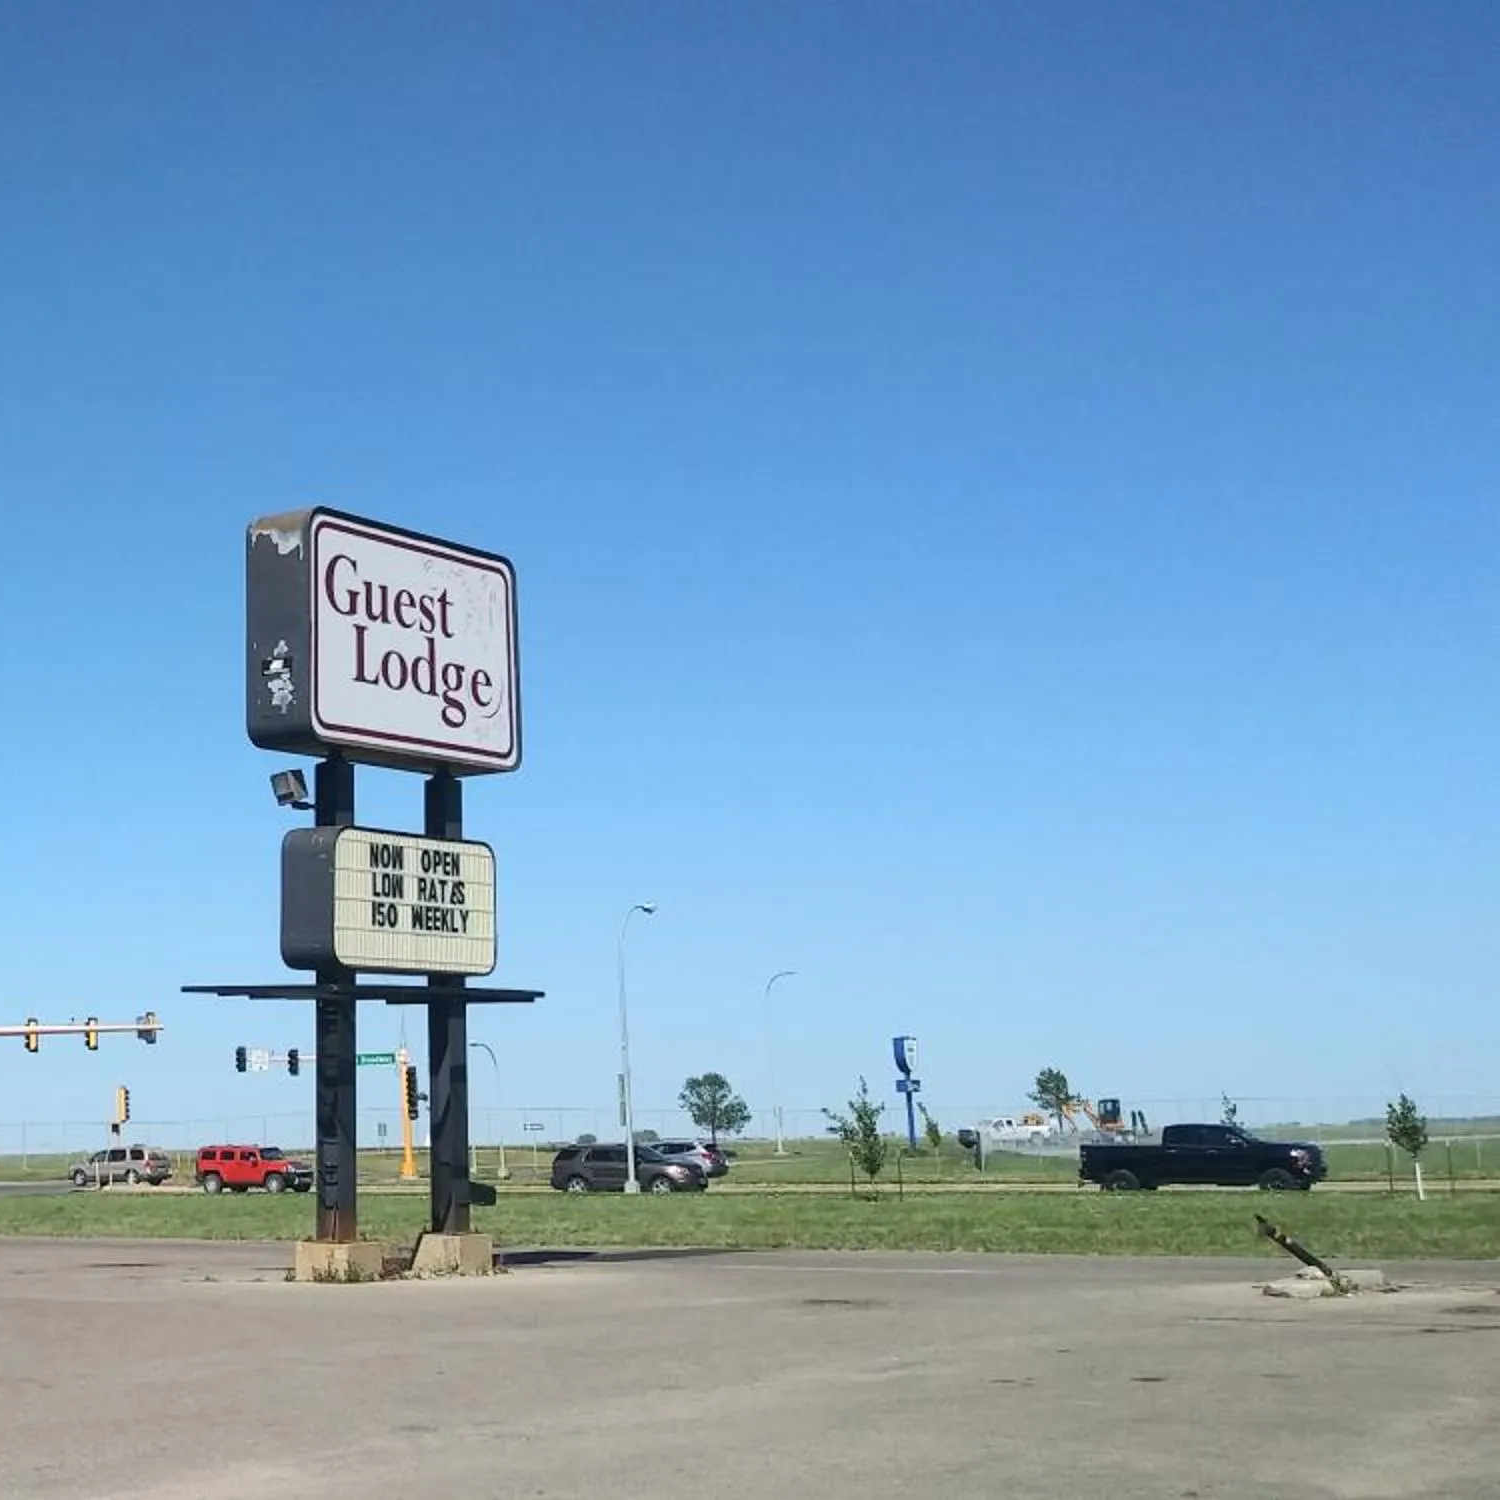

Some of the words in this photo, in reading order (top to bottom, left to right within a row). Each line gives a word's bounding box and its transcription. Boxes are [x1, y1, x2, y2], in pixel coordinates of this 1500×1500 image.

[325, 555, 454, 638] Guest
[352, 623, 493, 728] Lodge
[369, 843, 403, 870] NOW
[421, 849, 461, 876] OPEN
[372, 871, 403, 899] LOW
[372, 901, 398, 928] 150
[411, 905, 469, 934] WEEKLY
